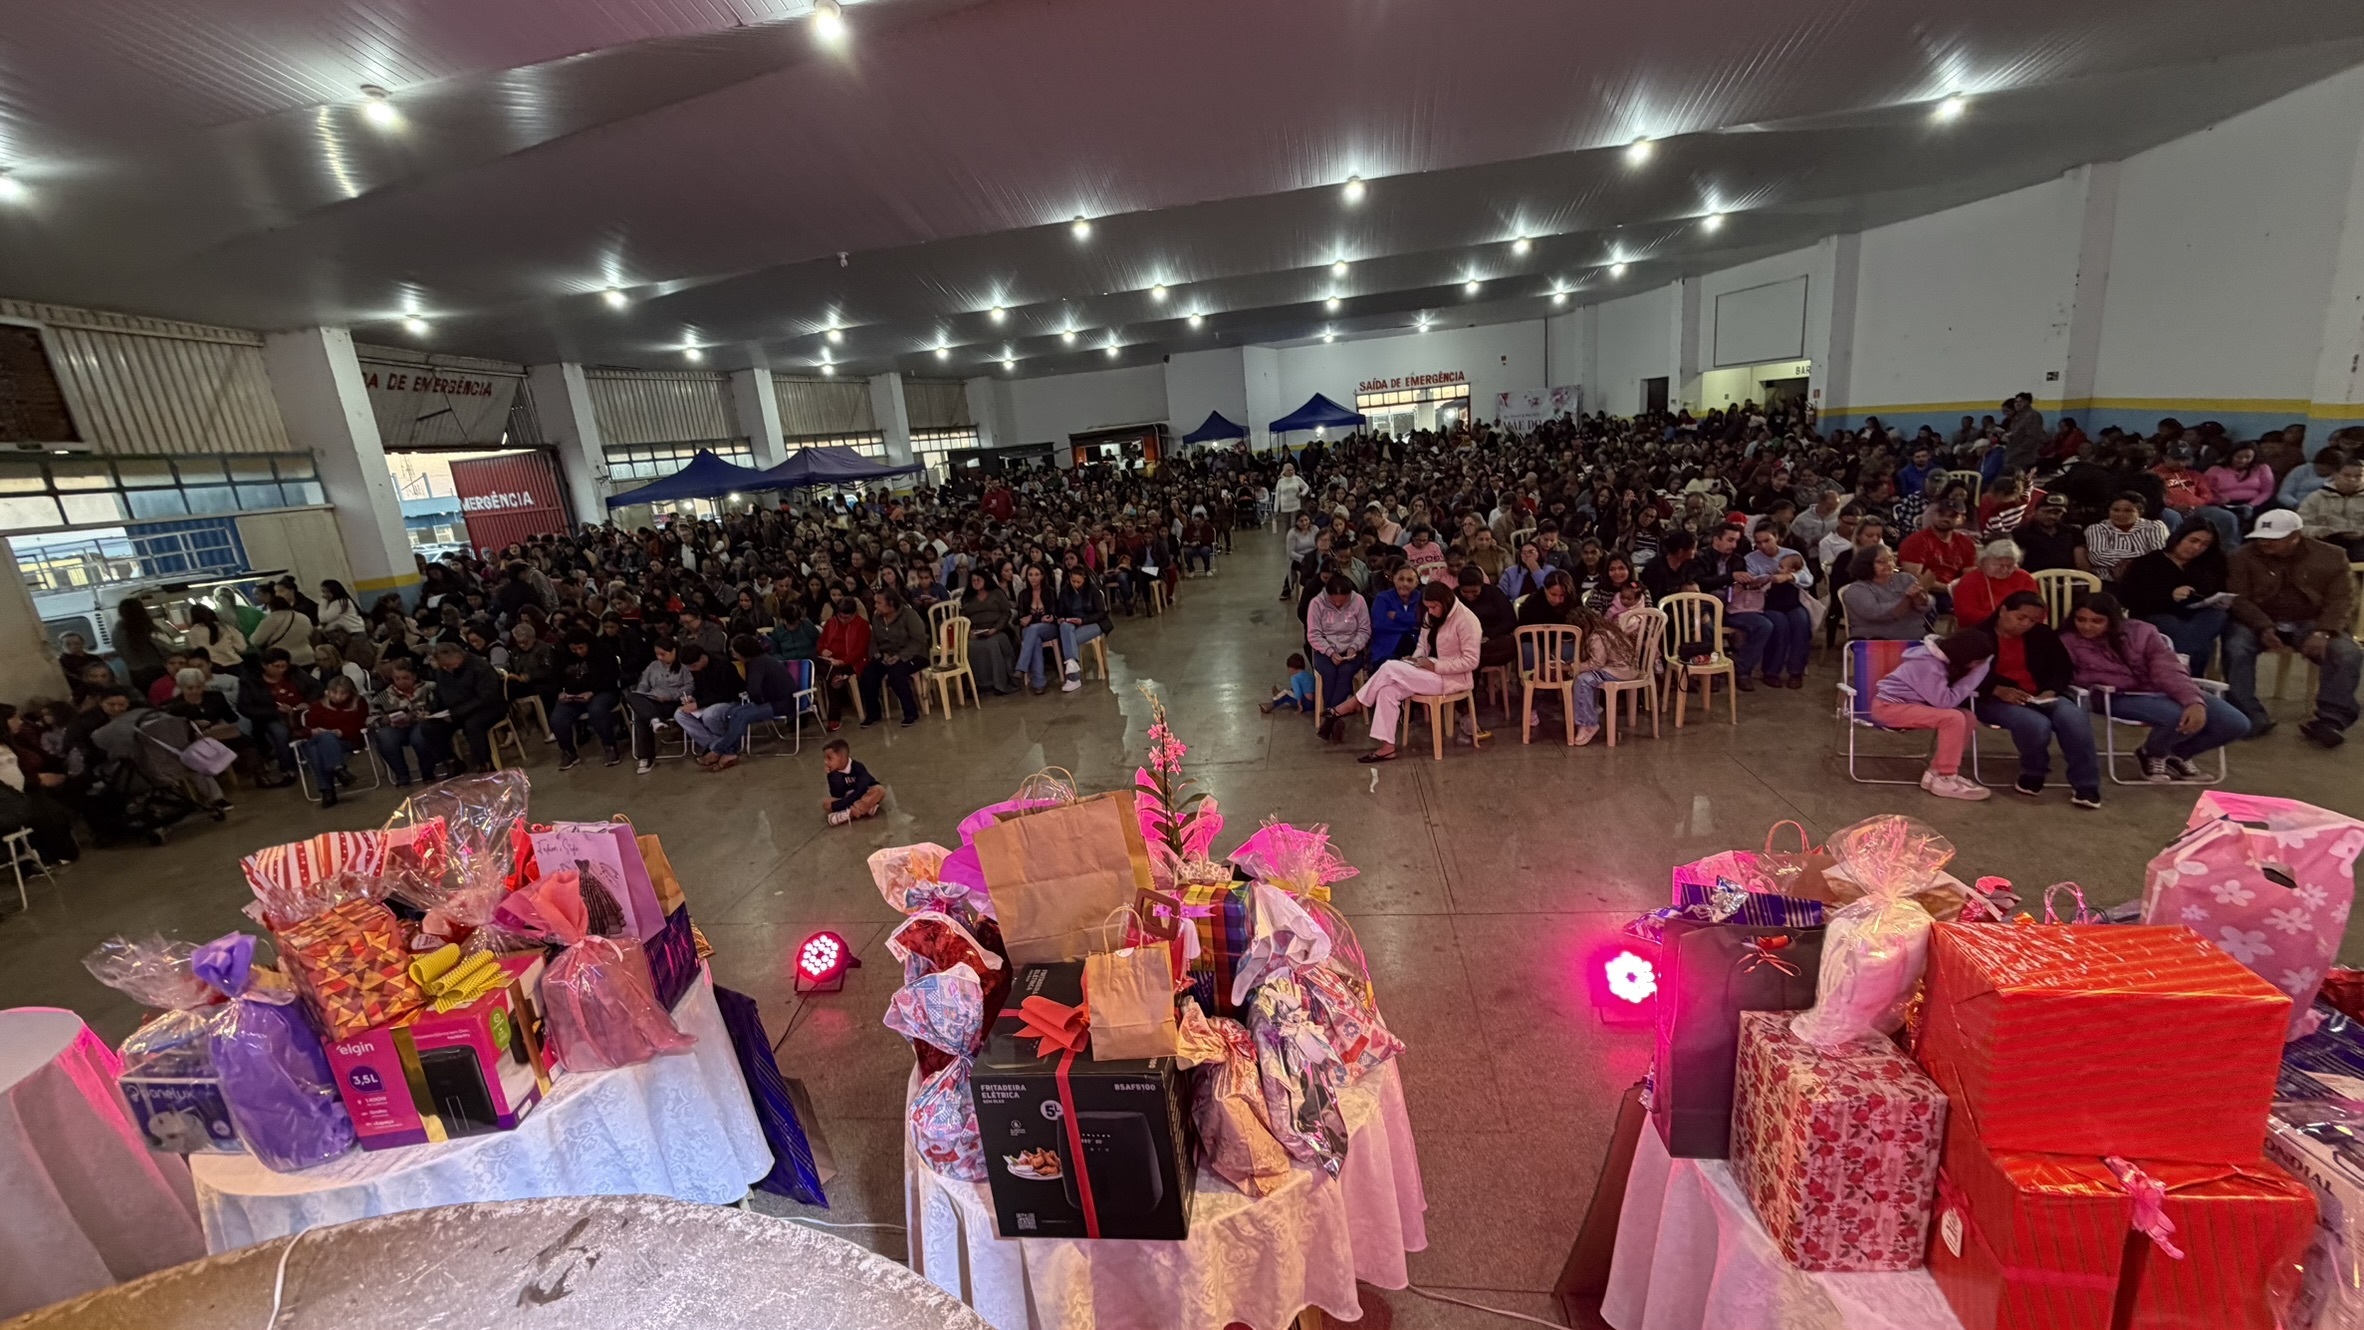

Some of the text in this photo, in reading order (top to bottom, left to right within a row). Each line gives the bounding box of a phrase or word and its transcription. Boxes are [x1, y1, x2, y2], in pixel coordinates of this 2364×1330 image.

[1796, 366, 1811, 375] BAR
[387, 374, 408, 391] DE
[412, 375, 492, 397] EMERGÊNCIA
[1359, 370, 1465, 393] SAÍDA DE EMERGÊNCIA
[461, 491, 534, 512] MERGÊNCIA
[340, 1041, 375, 1057] elgin
[352, 1073, 379, 1087] 3,5L
[980, 1083, 1027, 1092] FRITADEIRA
[981, 1090, 1020, 1099] ELÉTRICA
[2263, 1136, 2334, 1194] ONDIAL
